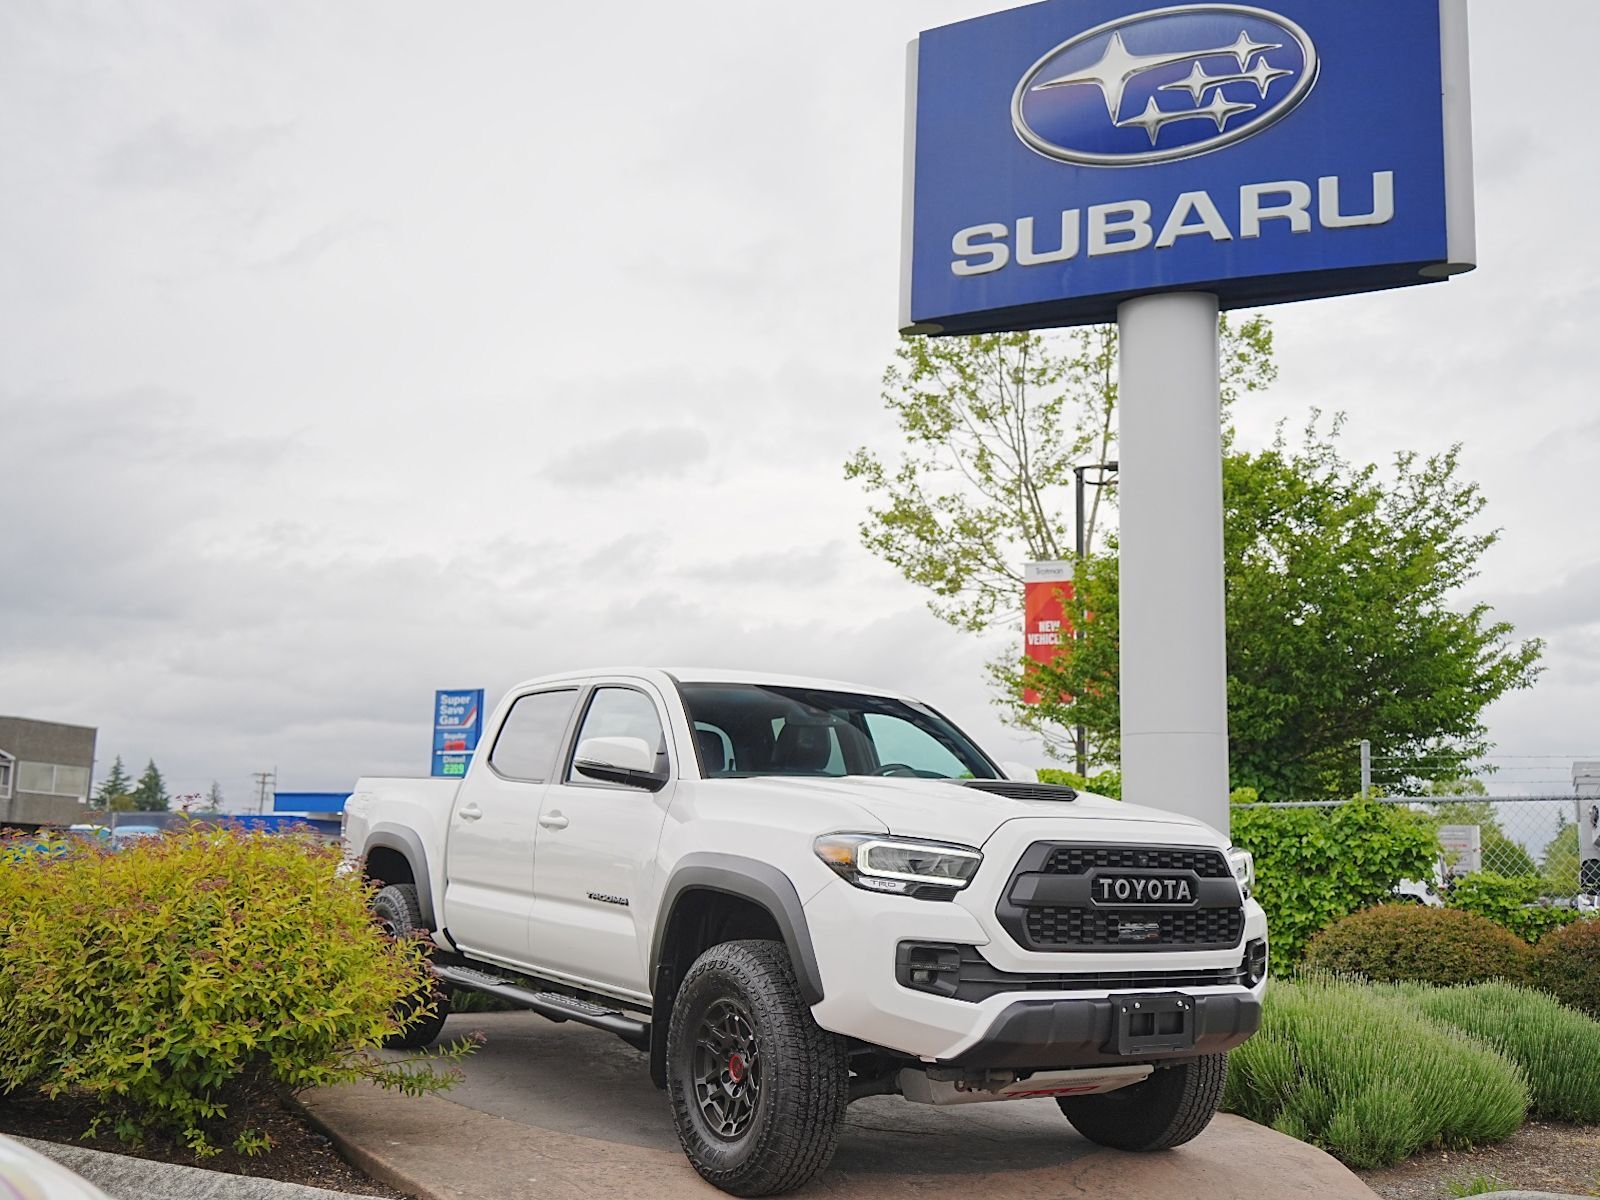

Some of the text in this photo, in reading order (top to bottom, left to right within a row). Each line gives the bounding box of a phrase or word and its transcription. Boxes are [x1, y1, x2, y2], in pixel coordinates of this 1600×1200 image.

[950, 170, 1395, 277] SUBARU
[1038, 620, 1061, 632] NEW
[440, 695, 471, 705] Super
[440, 705, 465, 715] Save
[439, 715, 459, 725] Gas
[870, 880, 896, 888] TRD
[1099, 879, 1192, 900] TOYOTA
[586, 892, 629, 906] TACOMA
